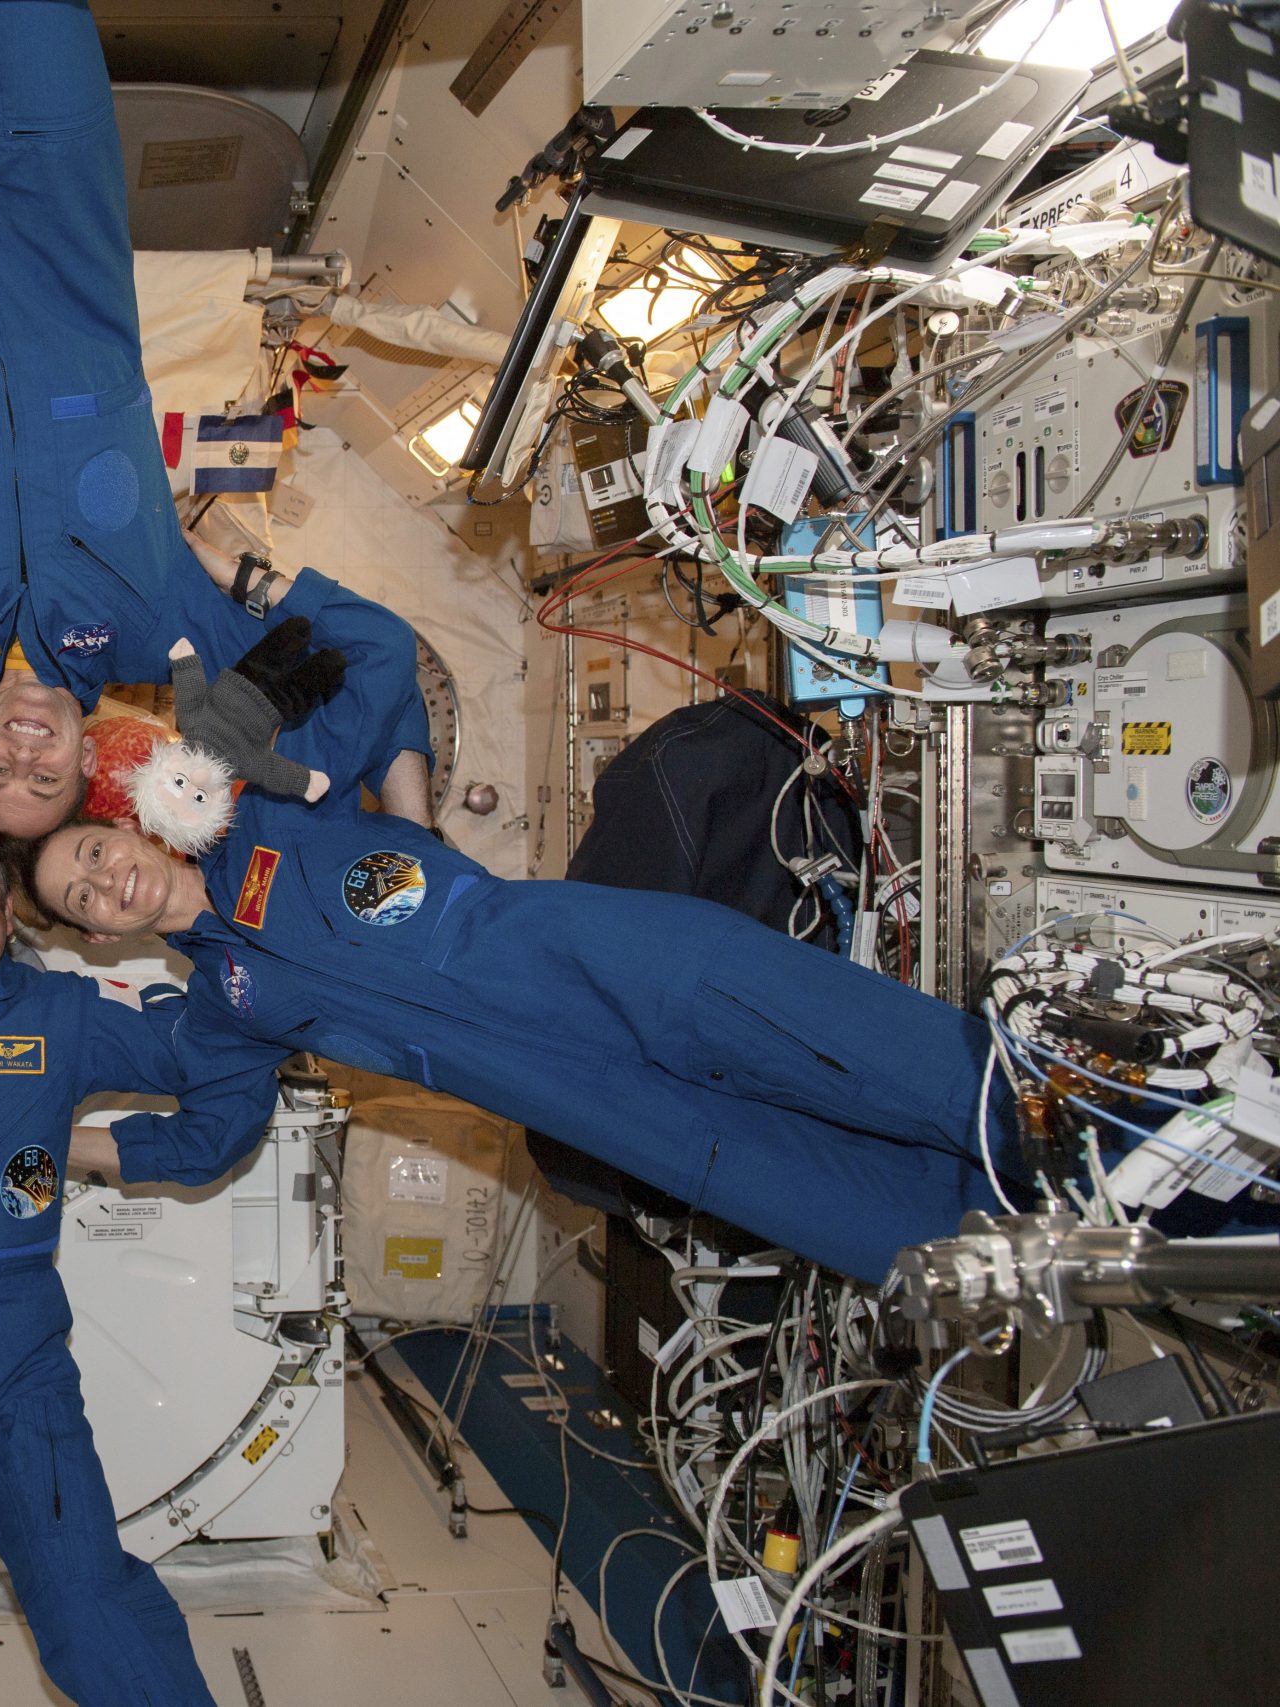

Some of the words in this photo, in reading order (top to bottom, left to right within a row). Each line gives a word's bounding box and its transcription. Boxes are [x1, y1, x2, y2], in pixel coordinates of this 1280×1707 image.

[1120, 162, 1133, 189] 4
[1055, 348, 1074, 361] STATUS
[1184, 565, 1200, 573] DATA
[263, 867, 271, 887] MANN
[348, 869, 369, 889] 68
[1243, 910, 1266, 919] LAPTOP
[7, 1060, 33, 1068] WAKATA
[23, 1150, 39, 1167] 68
